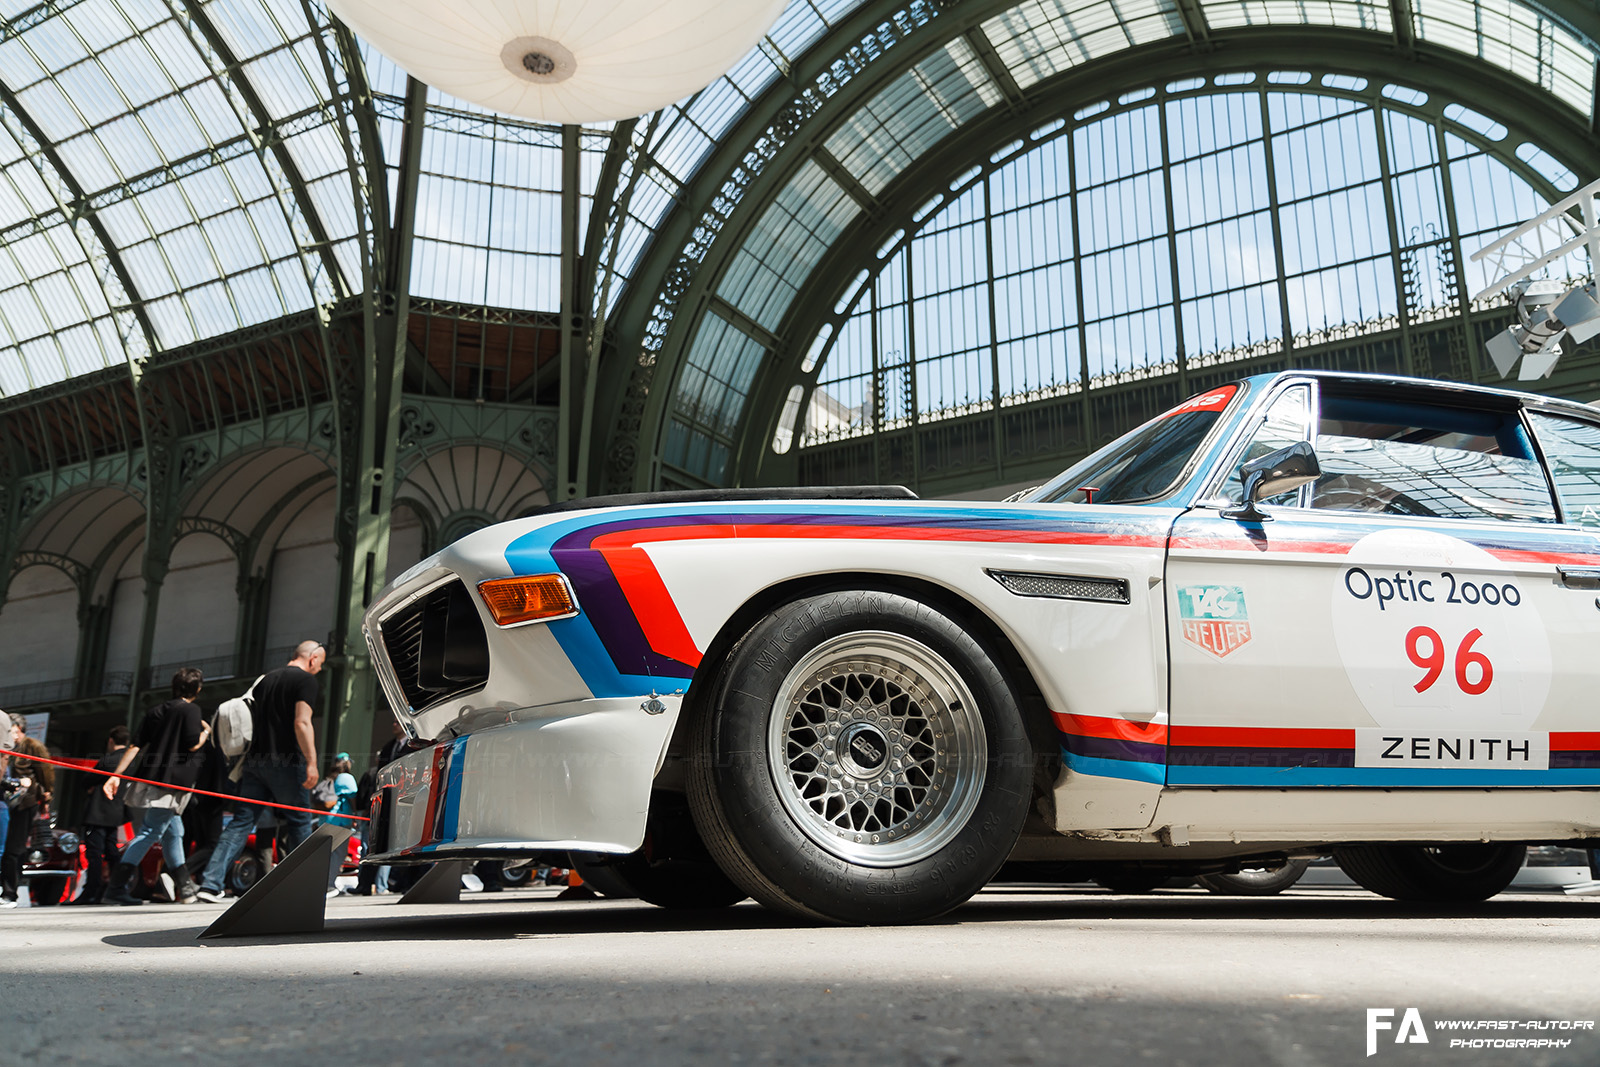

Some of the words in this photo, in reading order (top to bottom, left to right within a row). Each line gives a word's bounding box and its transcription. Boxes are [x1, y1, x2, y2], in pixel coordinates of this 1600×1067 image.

[1185, 586, 1238, 618] TAG
[1344, 566, 1435, 611] Optic
[1440, 571, 1521, 607] 2000
[754, 596, 883, 674] MICHELIN
[1185, 622, 1249, 655] HEUER
[1404, 625, 1494, 696] 96
[851, 735, 882, 762] BBS
[1381, 736, 1530, 761] ZENITH
[804, 859, 854, 892] RACING
